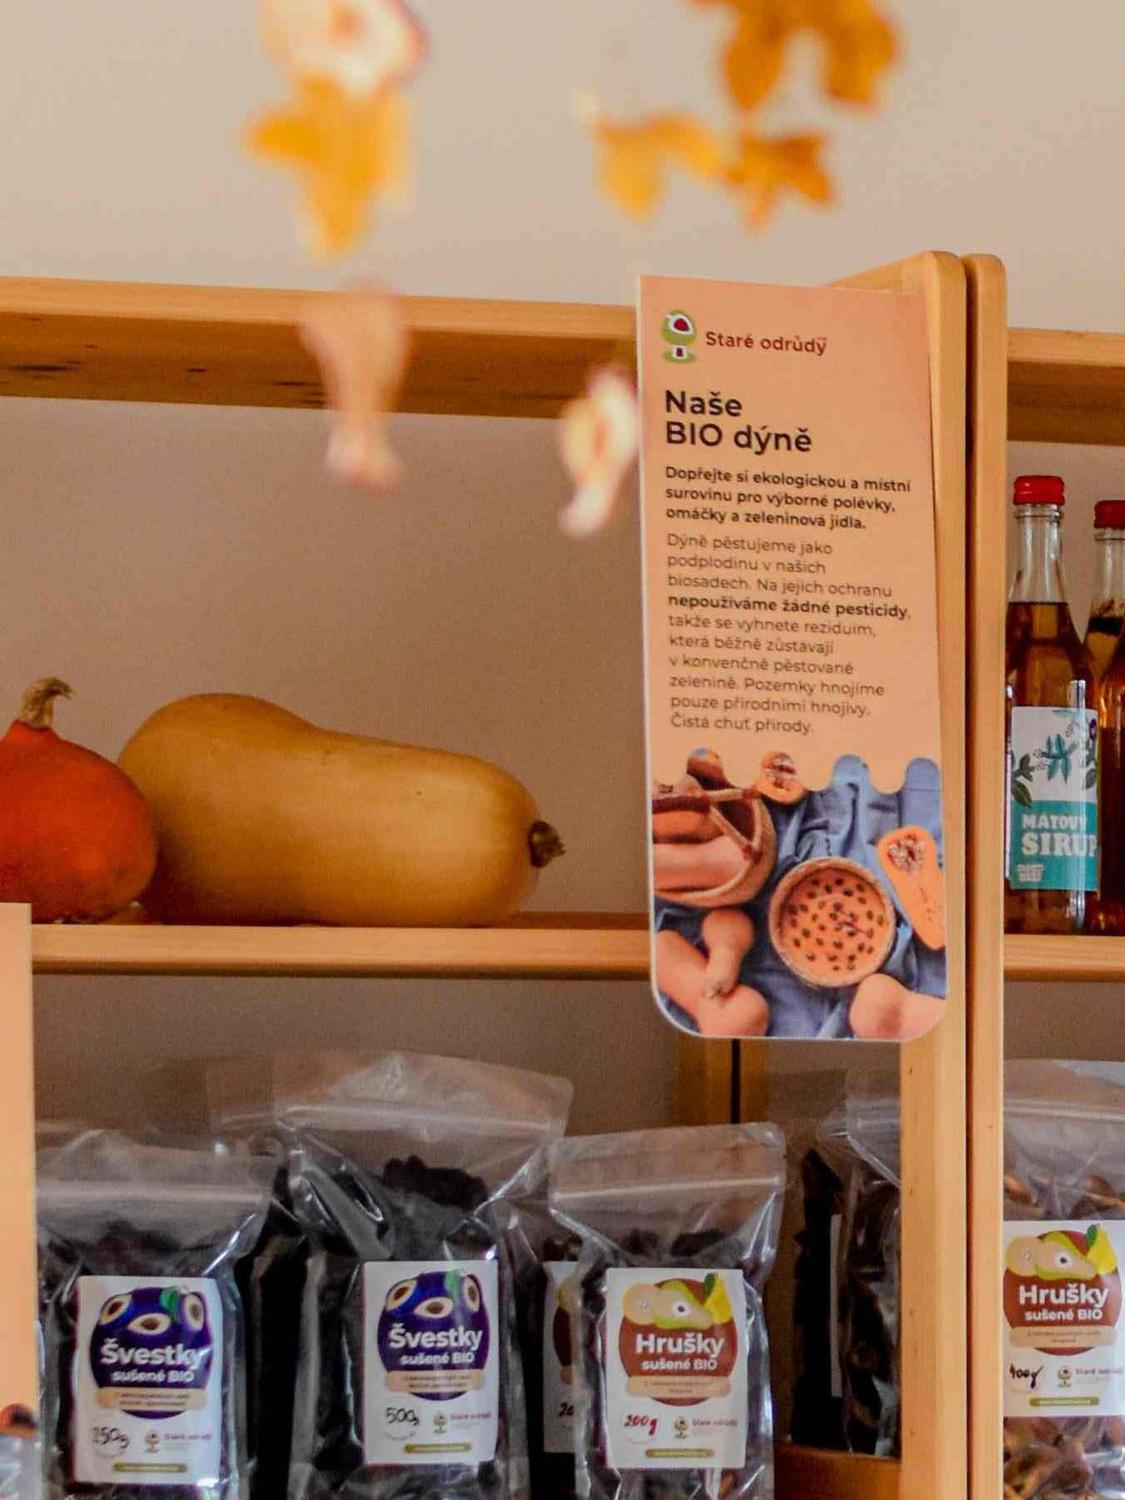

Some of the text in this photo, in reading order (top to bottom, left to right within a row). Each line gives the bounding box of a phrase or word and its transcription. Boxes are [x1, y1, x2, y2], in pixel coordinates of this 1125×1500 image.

[705, 331, 826, 356] Staré odrůdy
[665, 390, 742, 417] Naše
[666, 421, 812, 454] BIO dýně
[665, 466, 910, 492] Dopřejte si ekologickou místní
[665, 488, 895, 514] surovinu pro výborné polévky,
[665, 508, 866, 531] omáčky zeleninová jídla.
[666, 533, 833, 557] Dýně pěstujeme jako
[666, 555, 826, 574] podplodinu našich
[667, 573, 892, 597] biosadech. Na jejich ochranu
[668, 596, 910, 621] nepoužíváme žádné pesticidy,
[667, 614, 876, 638] takže se vyhnete reziduím,
[669, 634, 833, 657] která běžně zůstávají
[682, 654, 854, 675] konvenčně pěstované
[669, 676, 885, 698] zelenině. Pozemky hnojíme
[670, 696, 871, 718] pouze přírodními hnojivy.
[670, 713, 813, 736] Čistá chuť přírody.
[1019, 1283, 1109, 1305] Hrušky
[1025, 1307, 1103, 1321] sušené BIO
[390, 1323, 483, 1350] Švestky
[635, 1328, 725, 1357] Hrušky
[101, 1338, 211, 1370] Švestky
[452, 1353, 475, 1364] BIO
[641, 1358, 718, 1370] sušené BIO
[167, 1370, 194, 1383] BIO
